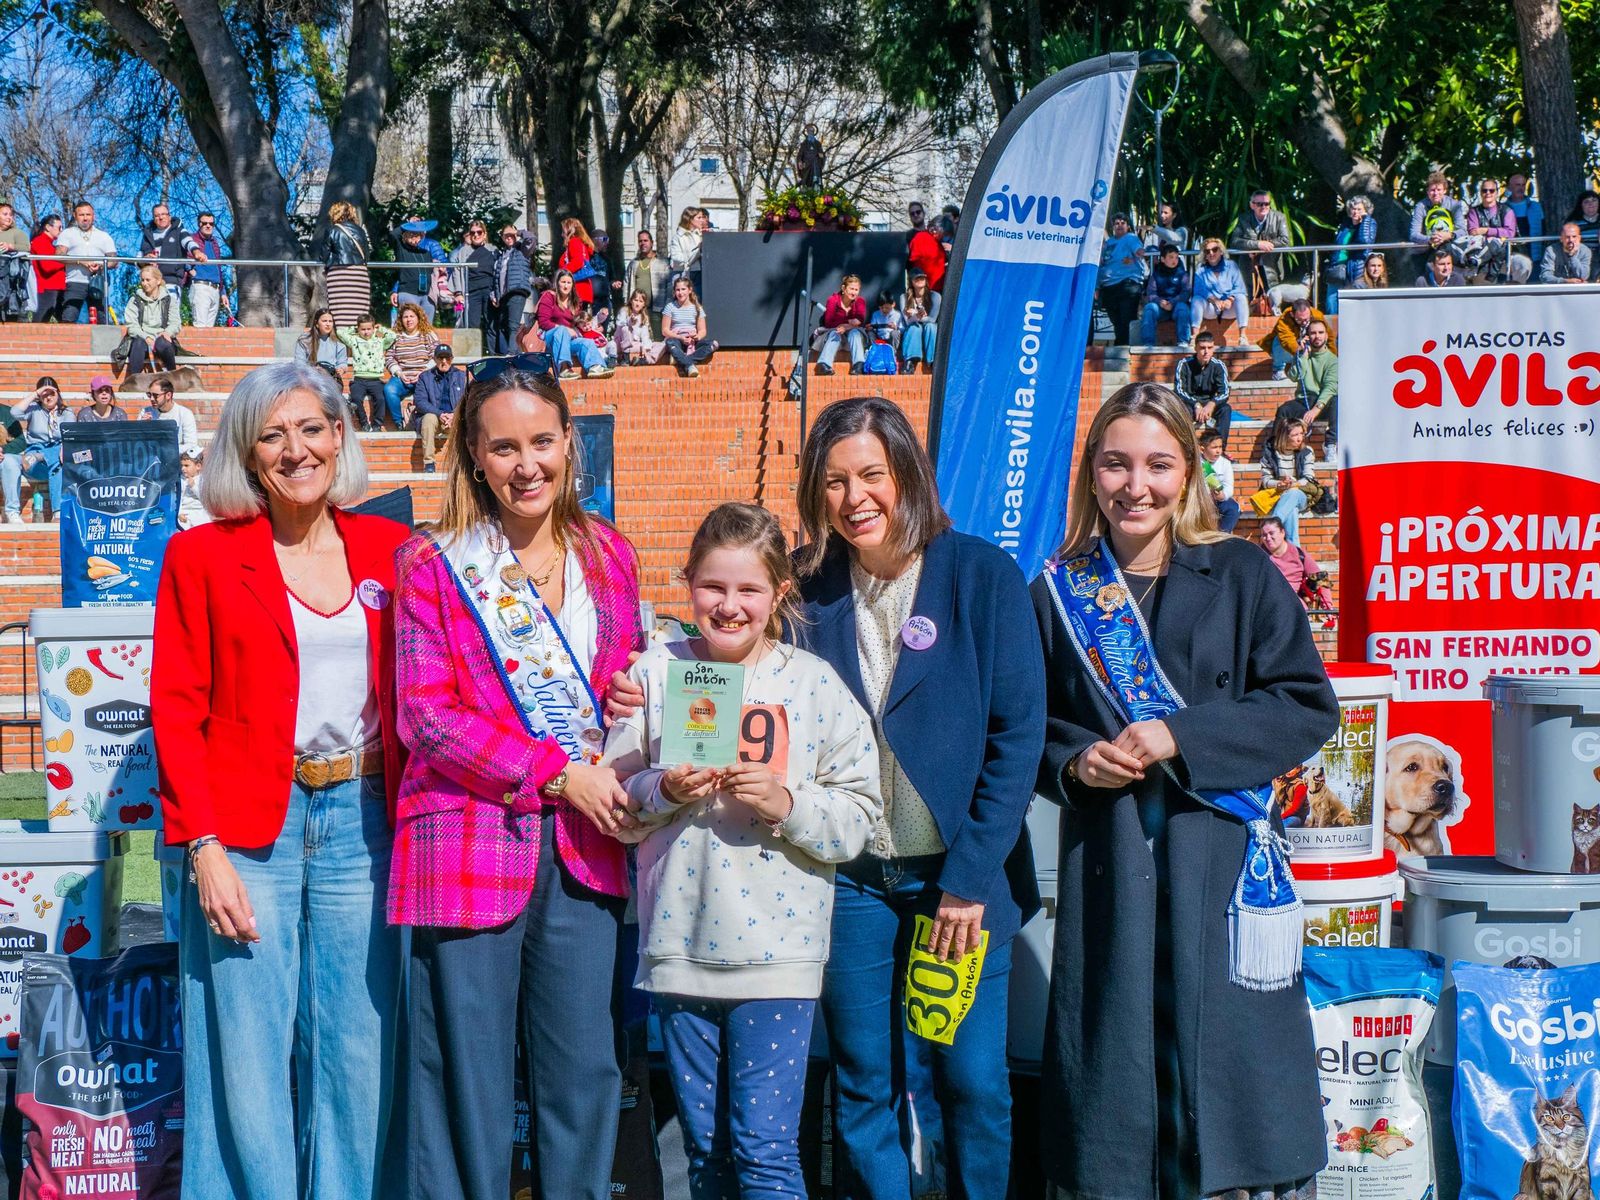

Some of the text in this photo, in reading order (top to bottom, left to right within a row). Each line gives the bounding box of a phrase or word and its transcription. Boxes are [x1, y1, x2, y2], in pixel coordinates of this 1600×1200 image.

[984, 226, 1085, 245] Clínicas Veterinaria
[1446, 331, 1565, 349] MASCOTAS
[994, 300, 1045, 559] nicasavila.com
[1412, 417, 1565, 438] Animales felices
[89, 484, 147, 499] ownat
[110, 518, 126, 532] NO
[1380, 505, 1600, 562] ¡PRÓXIMA
[94, 543, 135, 555] NATURAL
[1365, 562, 1600, 601] APERTURA
[1374, 635, 1592, 660] SAN FERNANDO
[684, 670, 727, 685] Antón
[695, 662, 714, 674] San
[1405, 668, 1469, 691] TIRO
[96, 708, 145, 722] ownat
[739, 708, 775, 765] 9
[1321, 724, 1377, 750] elect
[84, 743, 149, 757] The NATURAL
[107, 754, 153, 779] REAL food
[1315, 833, 1363, 844] NATURAL
[0, 934, 35, 948] wnat
[1306, 924, 1379, 947] Select
[1473, 927, 1582, 960] Gosbi
[1, 986, 13, 994] EAL
[953, 1003, 968, 1024] San
[1490, 997, 1600, 1047] Gosbi
[1353, 1014, 1413, 1038] picart
[1316, 1038, 1408, 1076] elec
[57, 1058, 159, 1089] ownat
[1319, 1076, 1352, 1085] NGREDIENTS
[71, 1090, 140, 1103] THE REAL FOOD
[1349, 1096, 1394, 1106] MINI ADU
[52, 1120, 76, 1140] only
[126, 1120, 156, 1138] meat
[51, 1137, 85, 1152] FRESH
[93, 1126, 123, 1152] NO
[125, 1134, 156, 1150] meal
[51, 1151, 84, 1168] MEAT
[1347, 1165, 1369, 1173] RICE
[65, 1171, 141, 1195] NATURAL
